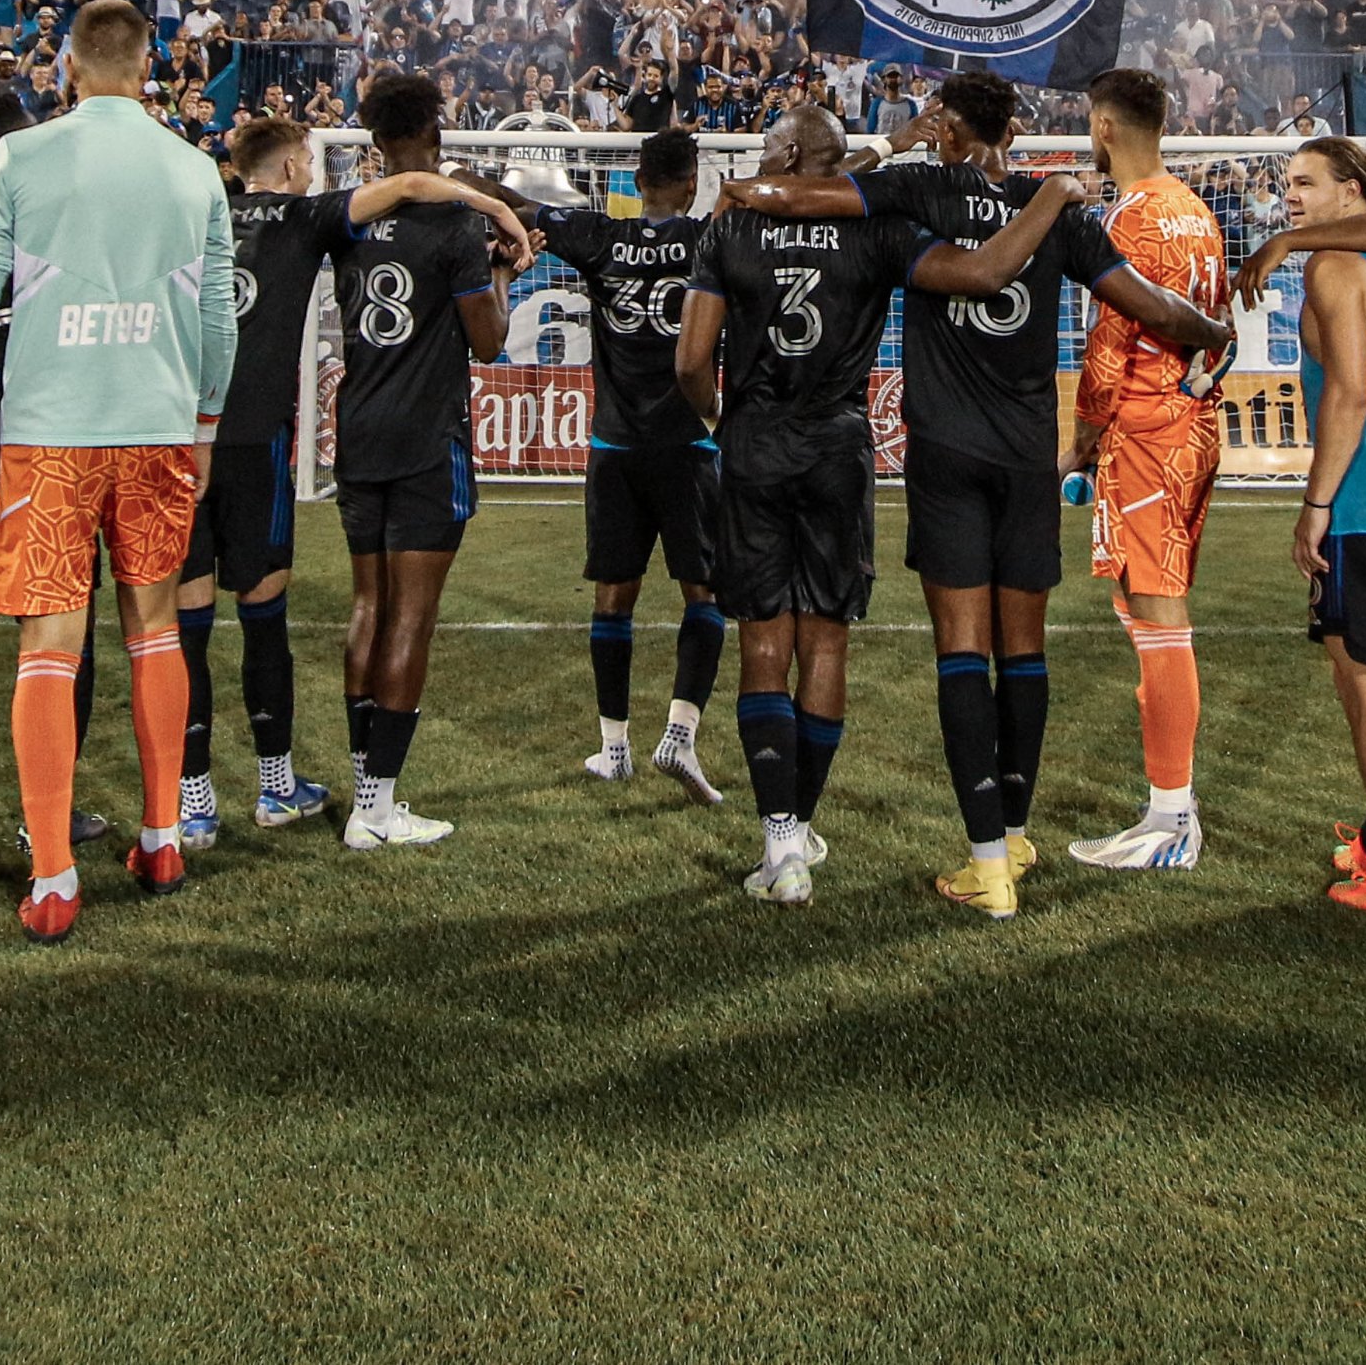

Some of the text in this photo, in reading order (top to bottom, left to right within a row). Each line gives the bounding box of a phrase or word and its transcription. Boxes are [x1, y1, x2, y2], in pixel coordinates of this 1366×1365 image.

[58, 302, 155, 347] BET99
[359, 261, 414, 349] 8
[767, 267, 824, 356] 3
[1218, 383, 1314, 448] nti
